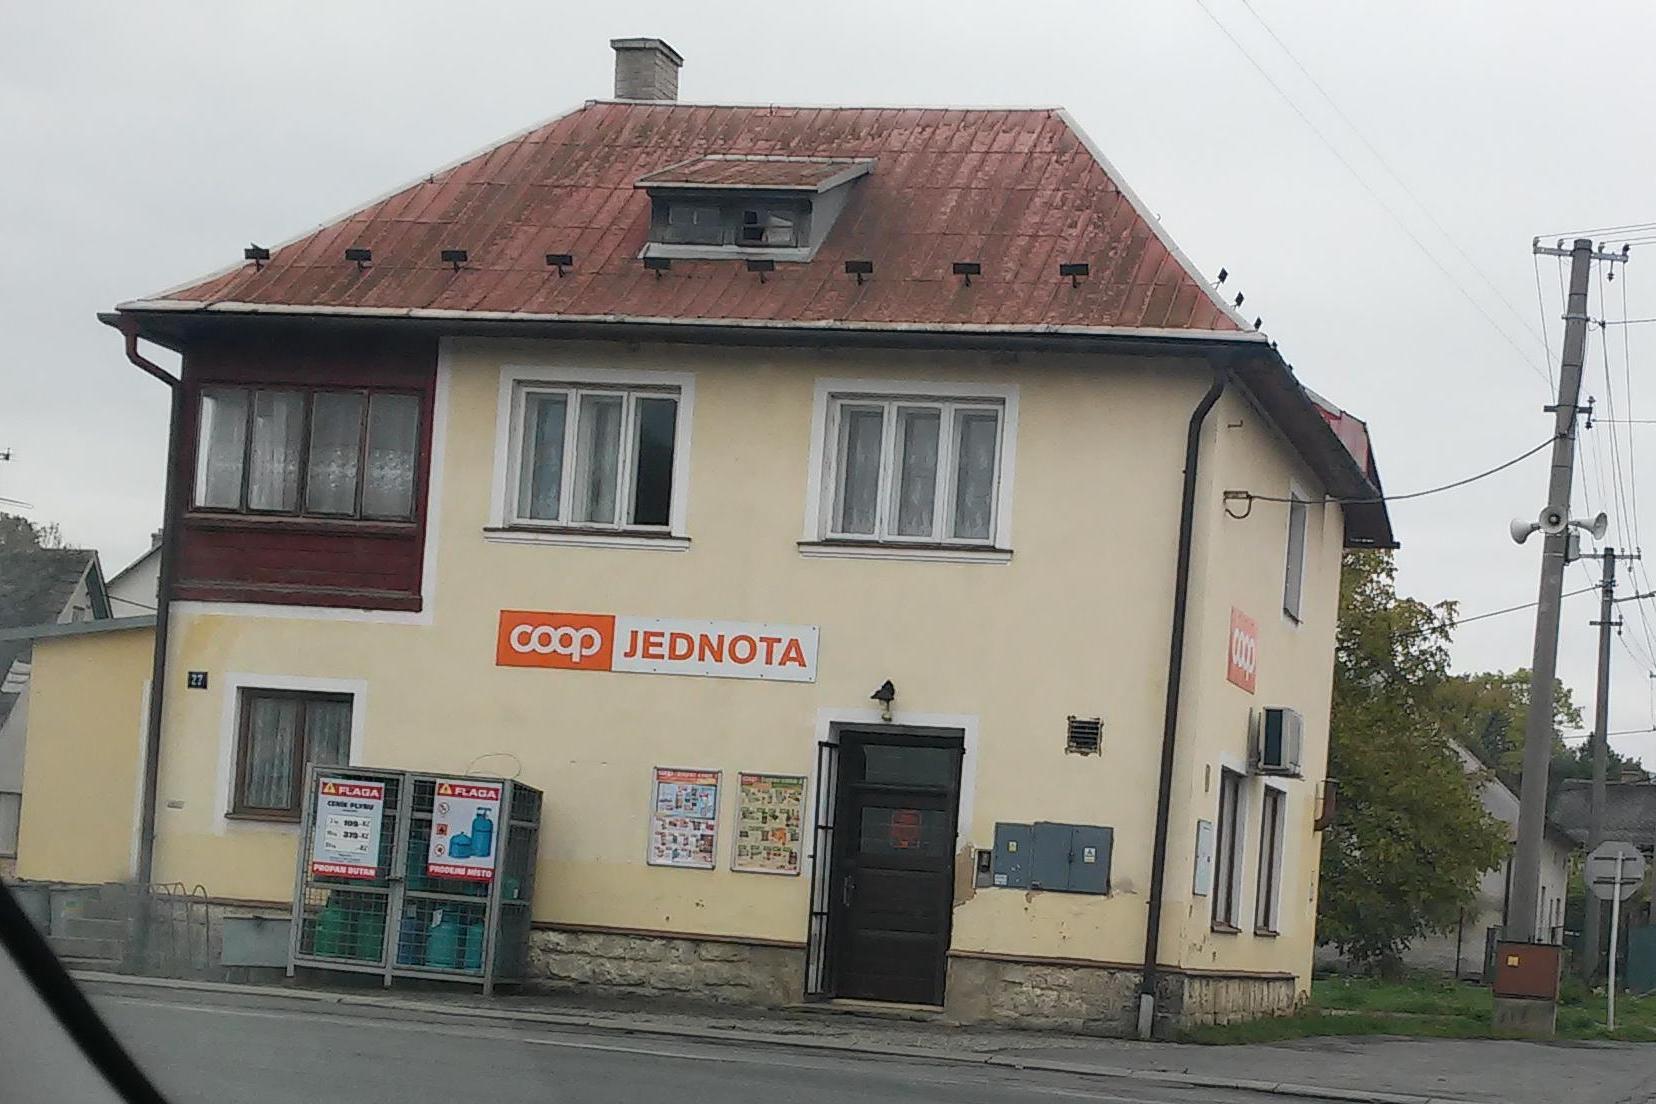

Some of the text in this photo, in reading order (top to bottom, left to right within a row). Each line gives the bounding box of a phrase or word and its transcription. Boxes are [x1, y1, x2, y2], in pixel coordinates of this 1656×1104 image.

[510, 624, 808, 668] coop JEDNOTA
[338, 786, 380, 798] FLAGA
[455, 787, 497, 799] FLAGA
